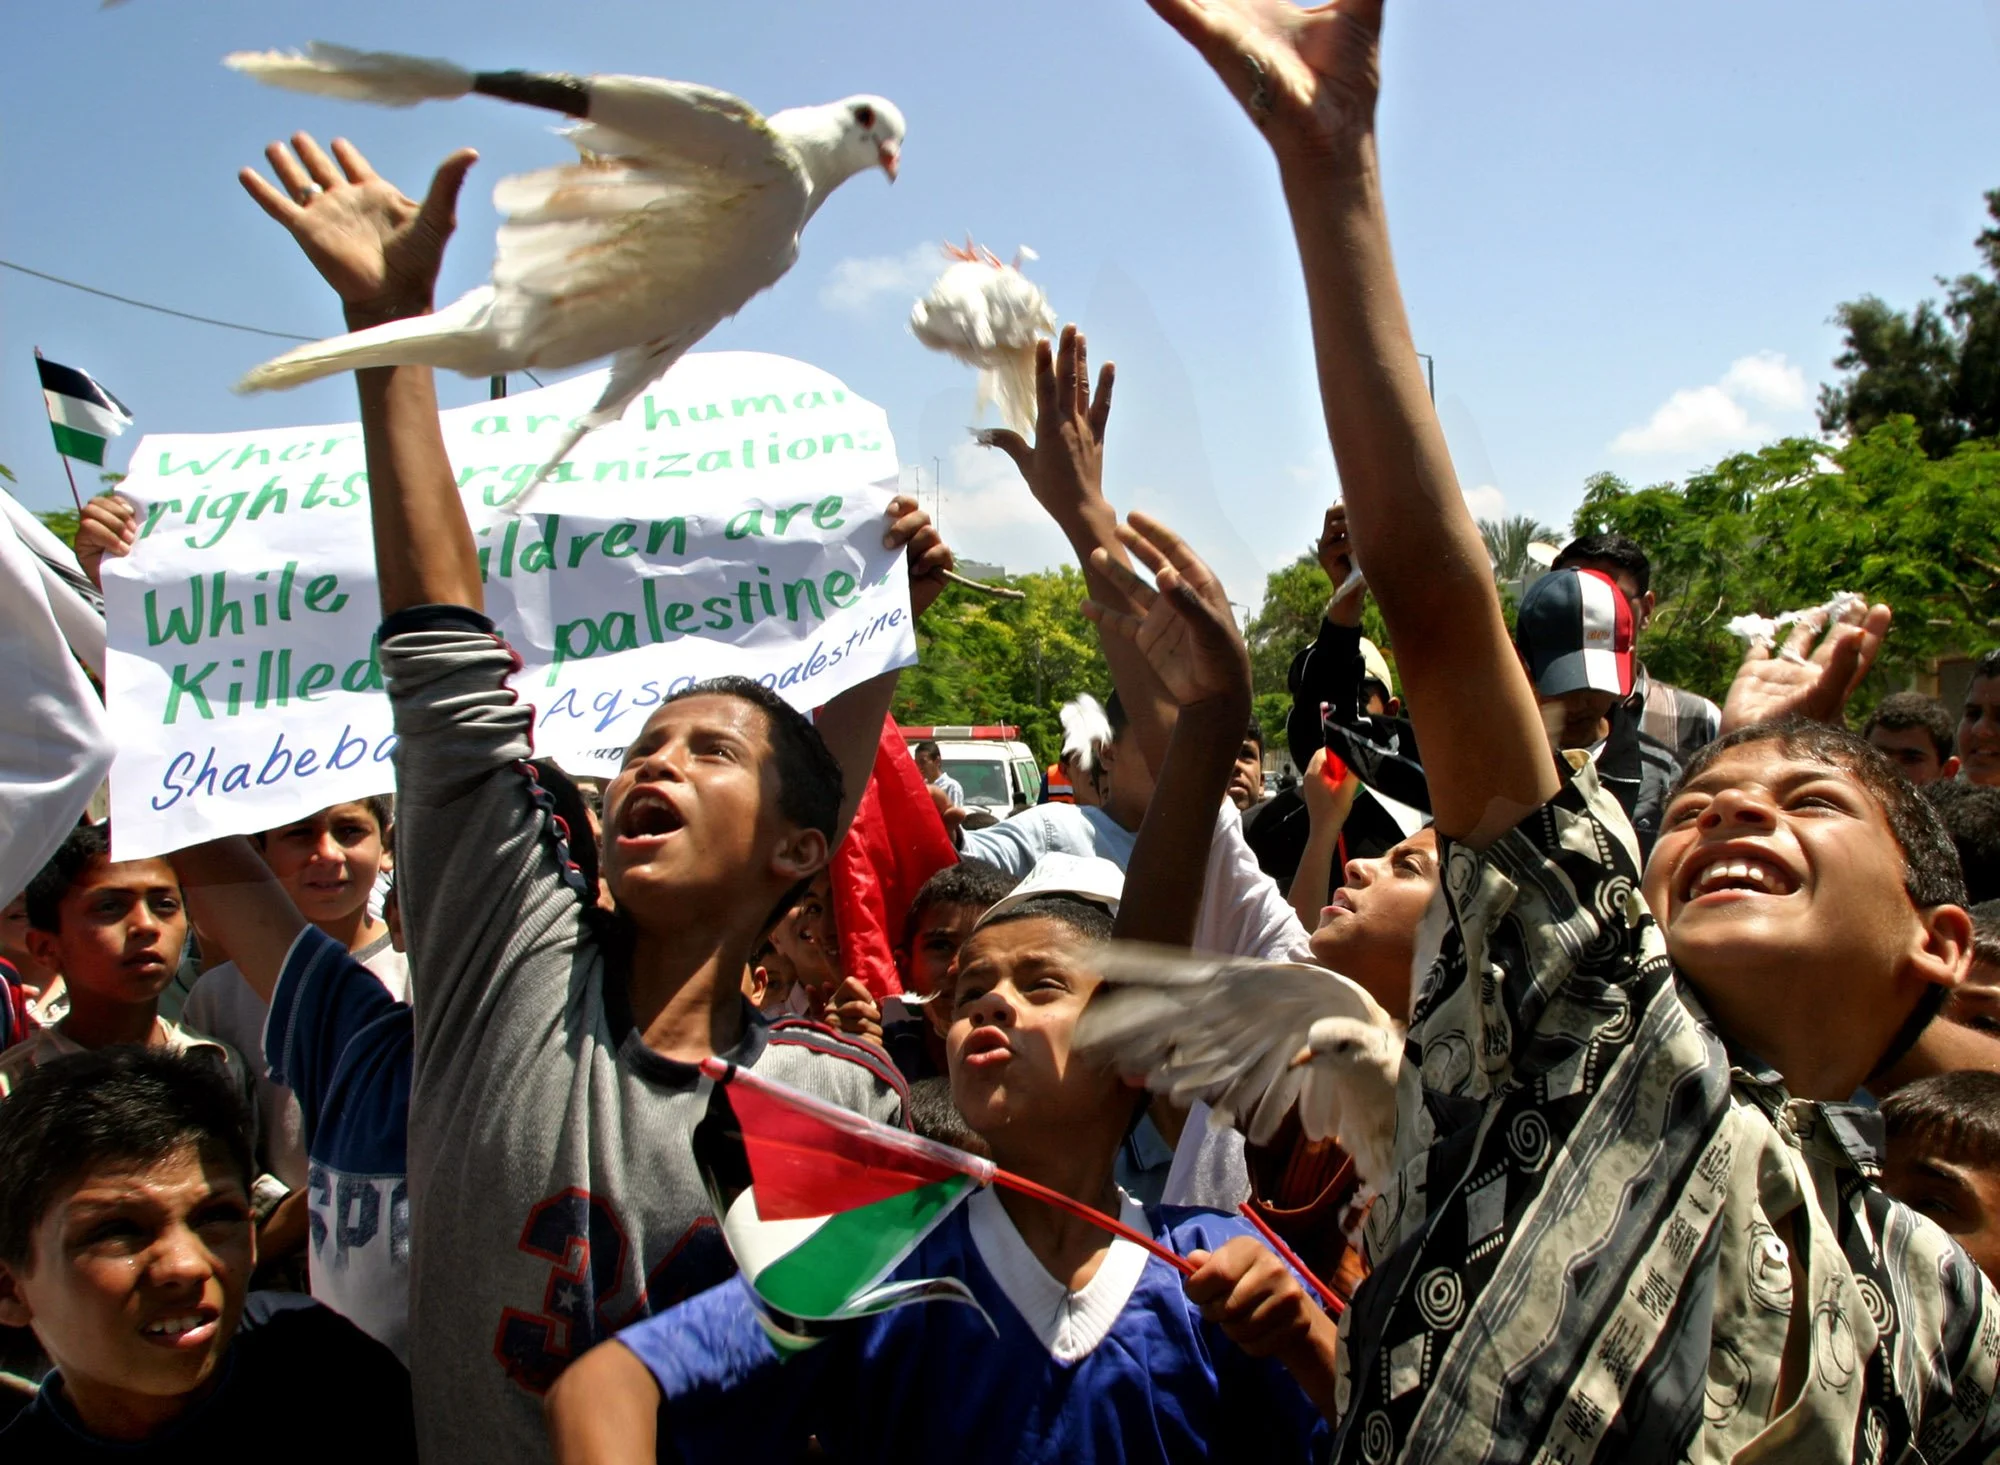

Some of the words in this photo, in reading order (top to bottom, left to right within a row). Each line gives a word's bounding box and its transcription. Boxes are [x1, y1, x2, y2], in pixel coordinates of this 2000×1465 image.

[139, 471, 370, 549] rights
[456, 430, 882, 507] rganizations
[158, 435, 359, 477] Wher
[144, 561, 350, 647] While
[478, 513, 687, 584] ildren
[724, 494, 846, 541] are
[163, 631, 384, 725] Killed
